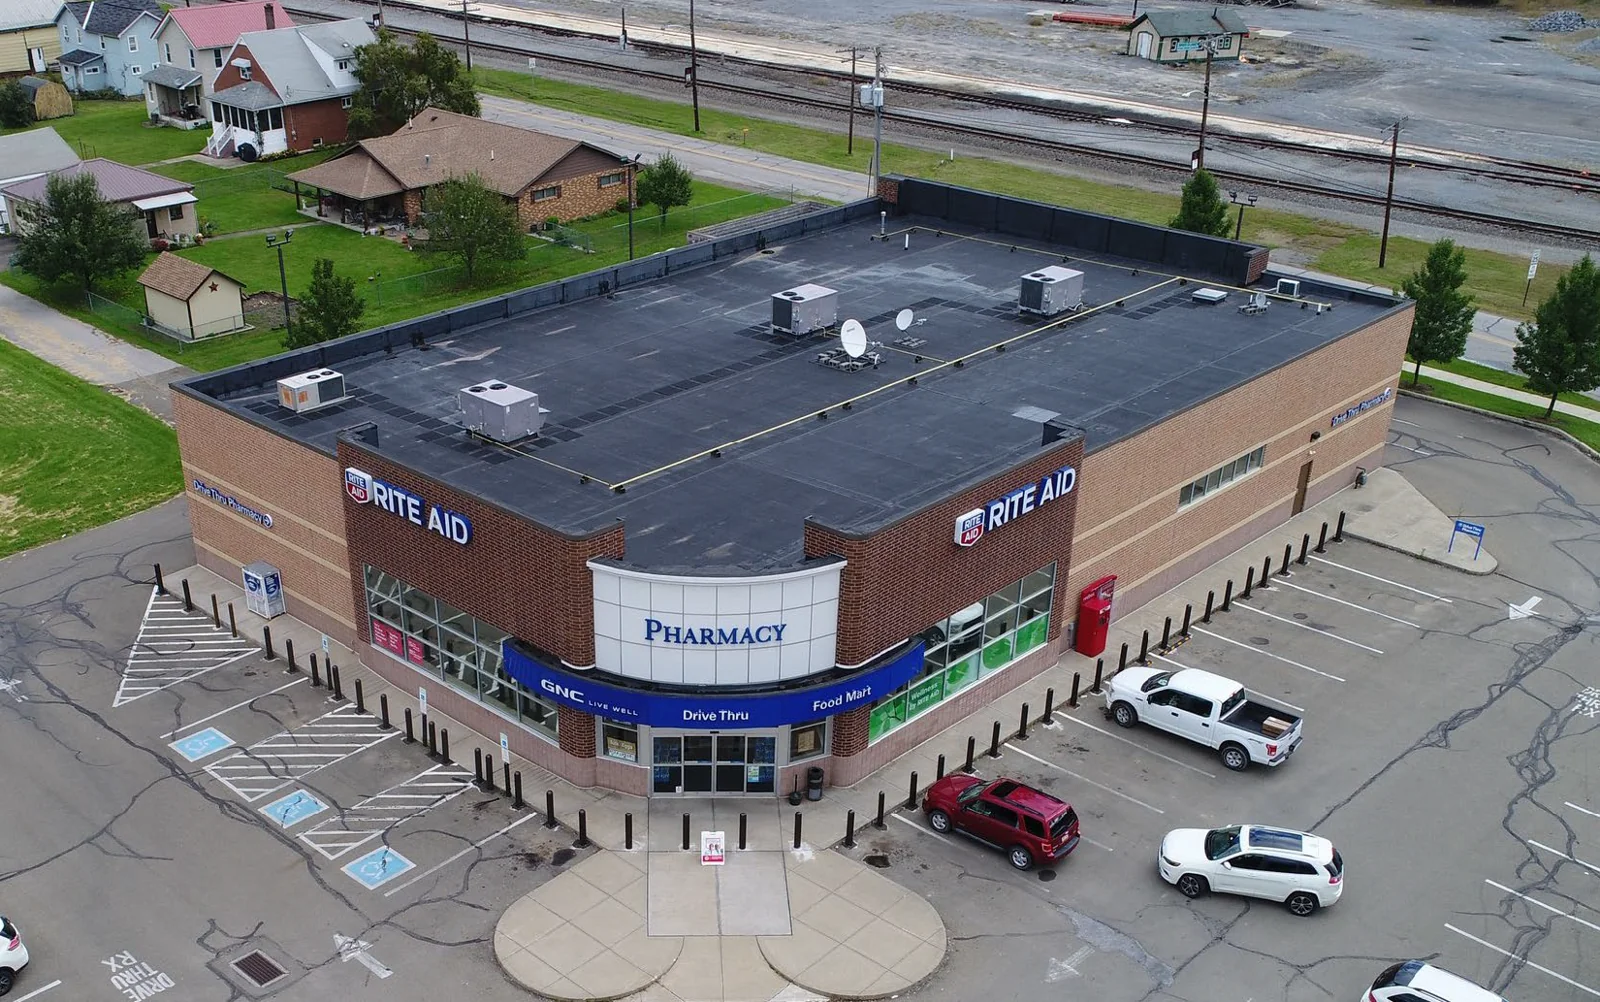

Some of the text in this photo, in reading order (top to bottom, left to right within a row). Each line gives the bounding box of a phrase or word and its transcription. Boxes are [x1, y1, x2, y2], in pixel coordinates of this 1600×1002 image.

[348, 473, 365, 487] RITE
[351, 485, 365, 499] AID
[193, 480, 262, 525] Drive Thru Pharmacy
[373, 480, 472, 545] RITE AID
[987, 466, 1076, 532] RITE AID
[964, 514, 982, 530] RITE
[965, 528, 979, 543] AID
[644, 618, 787, 645] PHARMACY
[541, 679, 638, 716] GNC LIVE WELL
[813, 684, 872, 711] Food Mart
[911, 682, 938, 700] Wellness
[683, 708, 749, 721] Drive Thru
[101, 950, 138, 973] RX
[111, 962, 159, 990] THRU
[122, 972, 176, 1002] DRIVE
